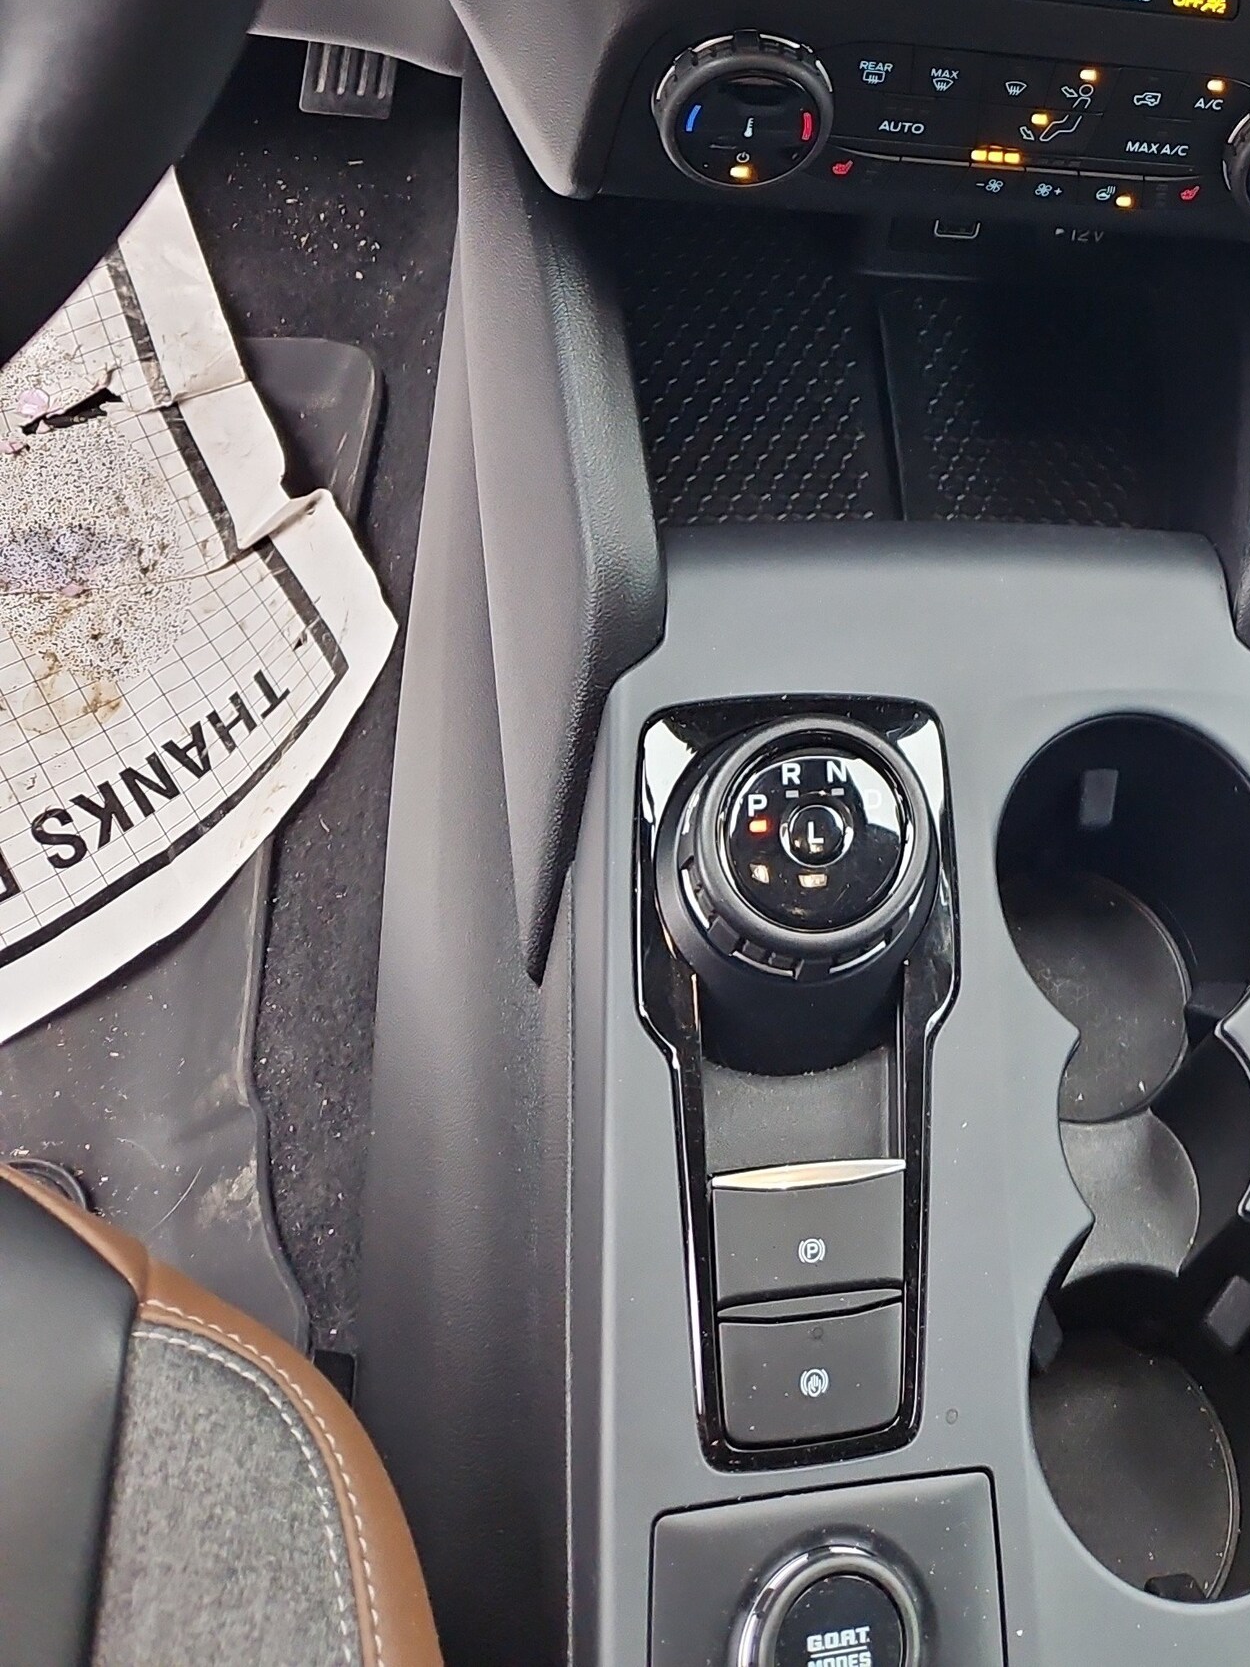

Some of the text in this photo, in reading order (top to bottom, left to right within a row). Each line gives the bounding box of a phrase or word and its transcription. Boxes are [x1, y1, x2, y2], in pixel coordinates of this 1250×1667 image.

[859, 60, 893, 72] REAR
[931, 68, 959, 80] MAX
[1194, 98, 1224, 110] A/C
[878, 120, 925, 134] AUTO
[1125, 140, 1189, 157] MAX A/C
[30, 669, 290, 869] THANKS
[781, 762, 801, 785] R
[826, 760, 848, 783] N
[747, 793, 768, 817] P
[807, 821, 825, 844] L
